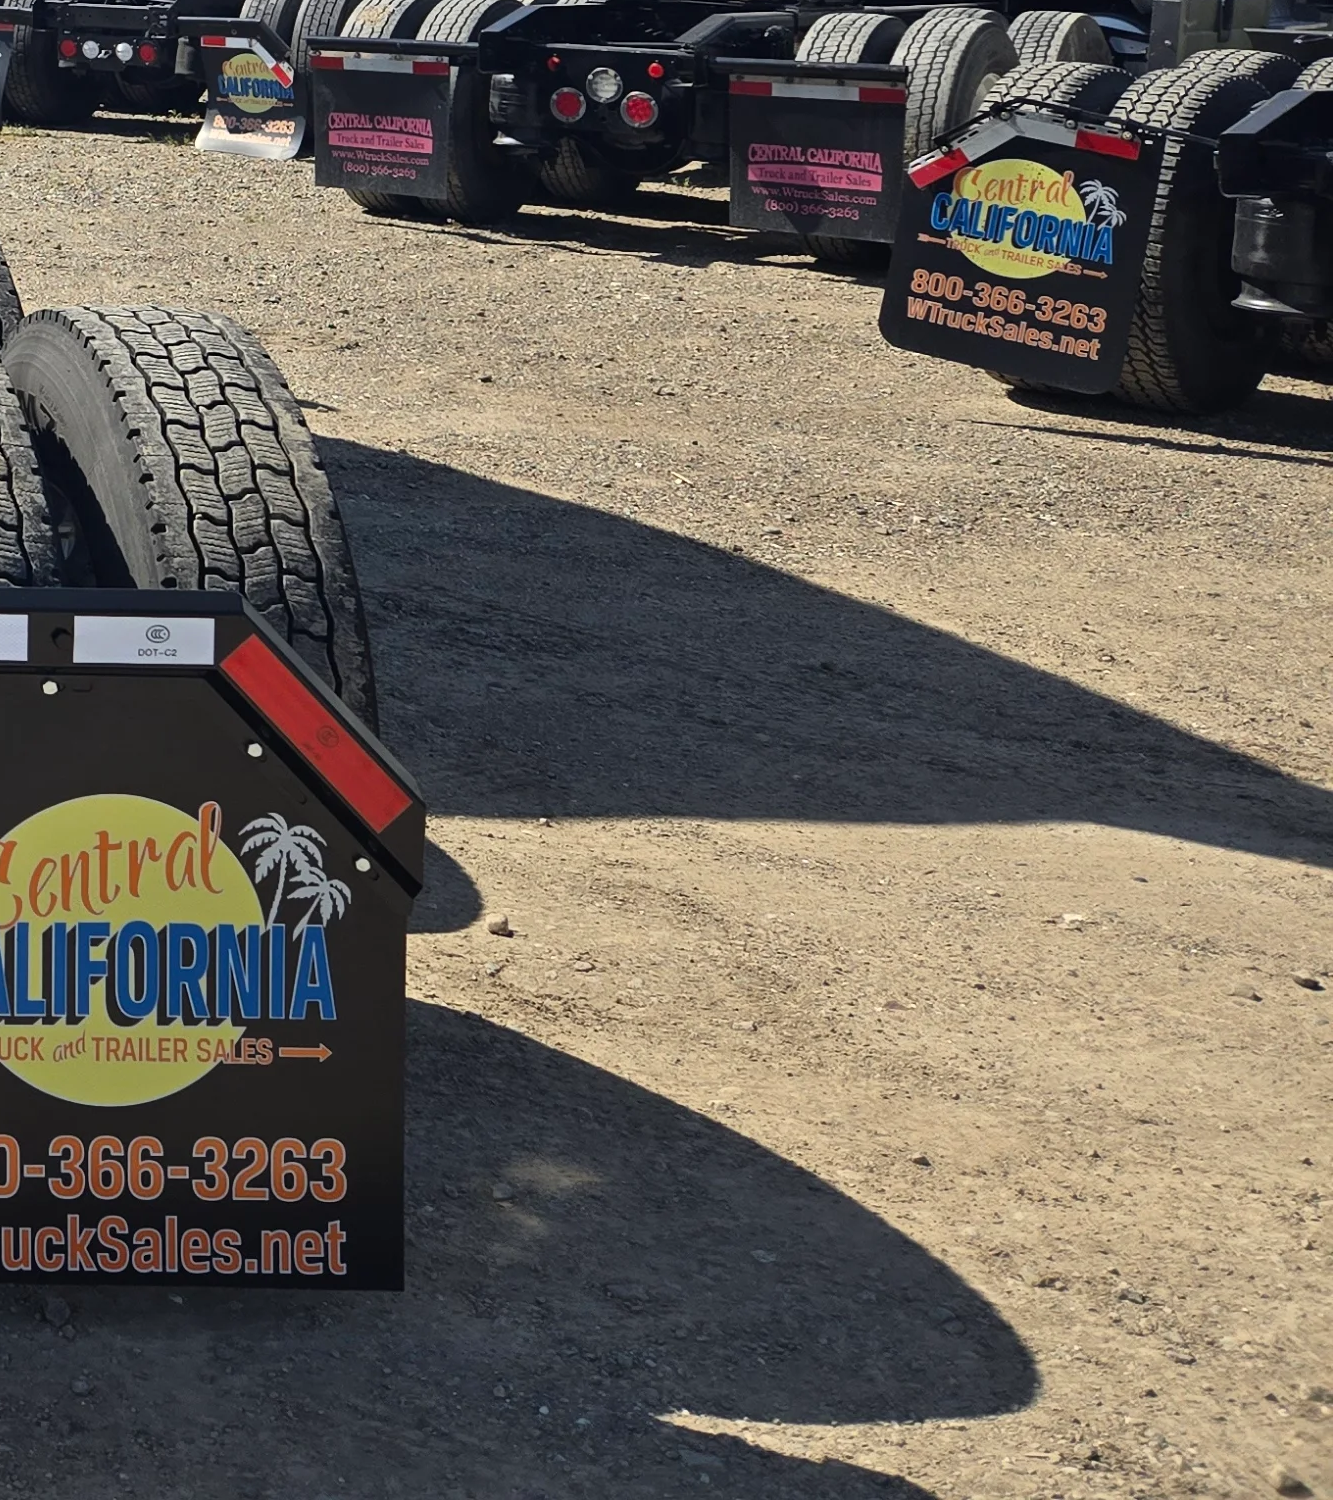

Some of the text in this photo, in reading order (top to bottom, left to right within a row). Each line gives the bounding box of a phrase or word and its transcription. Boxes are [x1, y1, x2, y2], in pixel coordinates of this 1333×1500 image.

[222, 60, 270, 77] Centra
[328, 112, 433, 137] CENTRAL CALIFORNIA
[337, 133, 425, 149] Truck and Trailer Sales
[342, 161, 416, 179] (800) 366-3263
[748, 143, 882, 173] CENTRAL CALIFORNIA
[758, 167, 871, 187] Truck and Trailer Sales
[953, 166, 1074, 207] Central
[764, 199, 859, 220] (800) 366-3263
[930, 192, 1113, 265] CALIFORNIA
[946, 237, 982, 255] TRUCK
[1001, 250, 1044, 268] TRAILER
[1046, 259, 1082, 276] SALES
[910, 268, 1107, 333] 800-366-3263
[907, 296, 1101, 360] WTruckSales.net
[137, 648, 177, 657] DOT-C2
[52, 1029, 87, 1063] and
[91, 1036, 189, 1064] TRAILER
[196, 1037, 274, 1065] SALES
